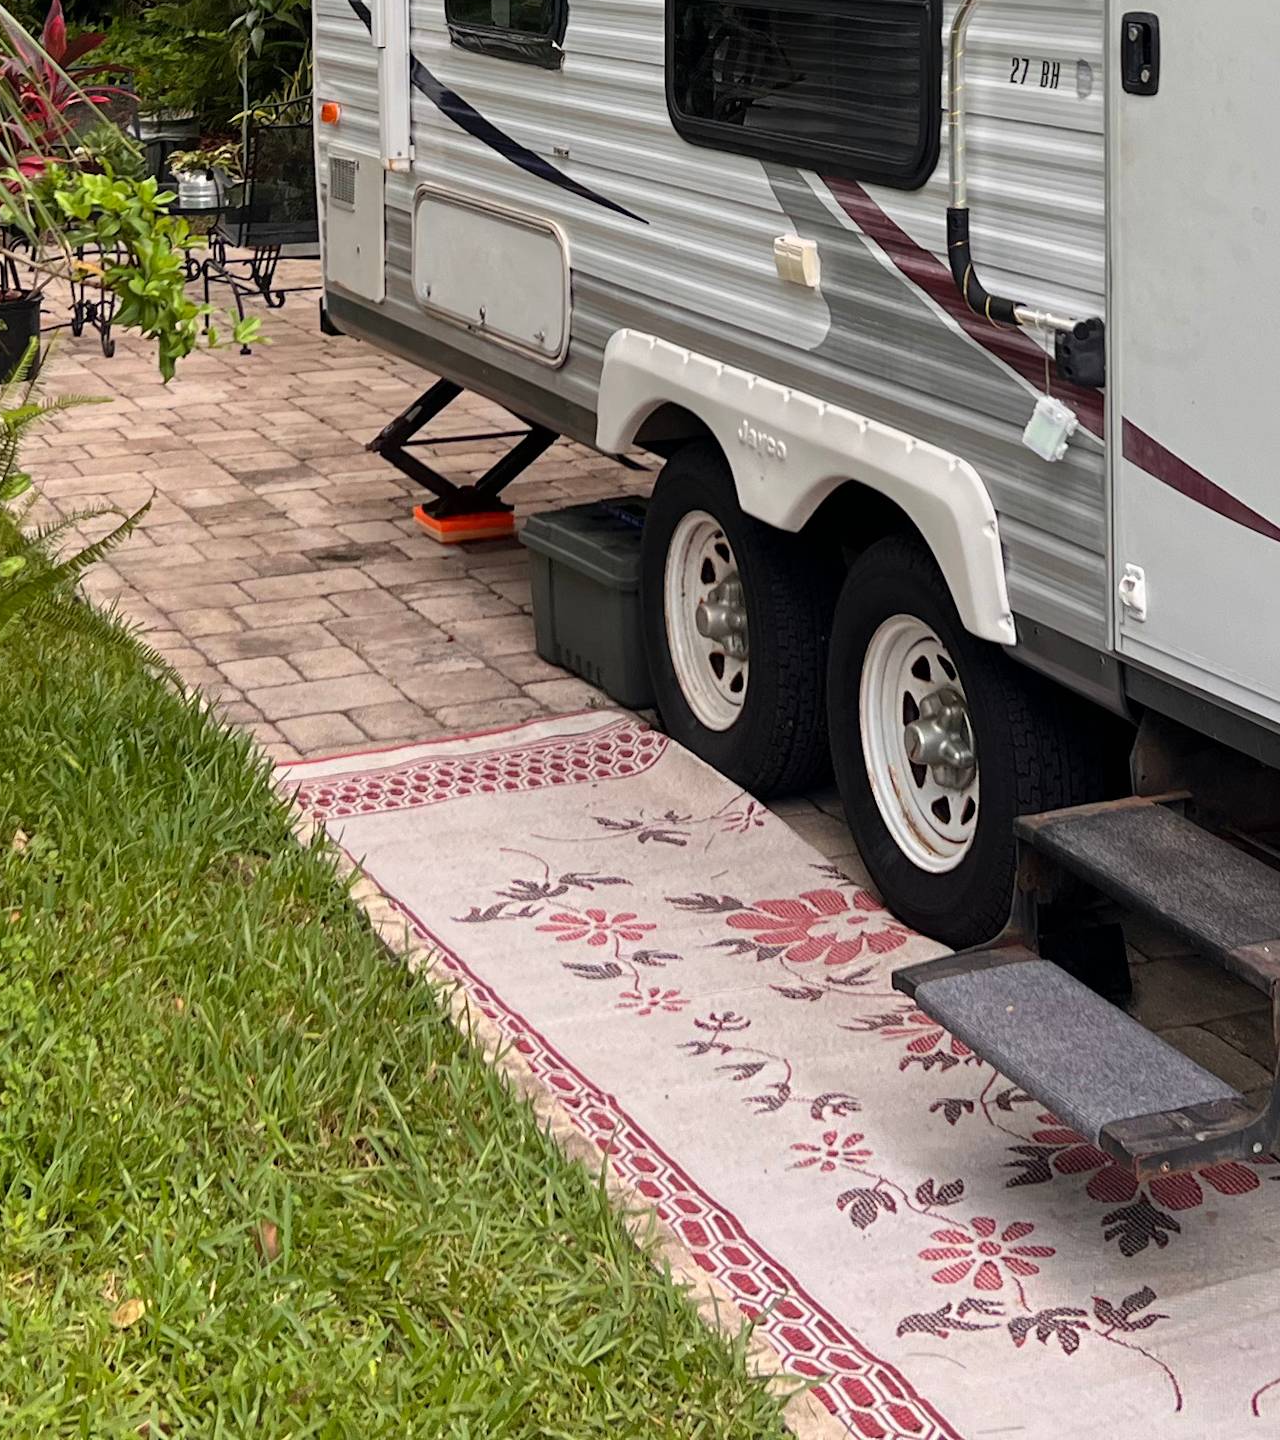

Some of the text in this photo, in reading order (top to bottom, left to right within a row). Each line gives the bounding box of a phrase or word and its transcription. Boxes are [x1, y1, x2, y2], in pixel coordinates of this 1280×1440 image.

[1009, 57, 1060, 89] 27 BH
[737, 418, 787, 461] Jayco
